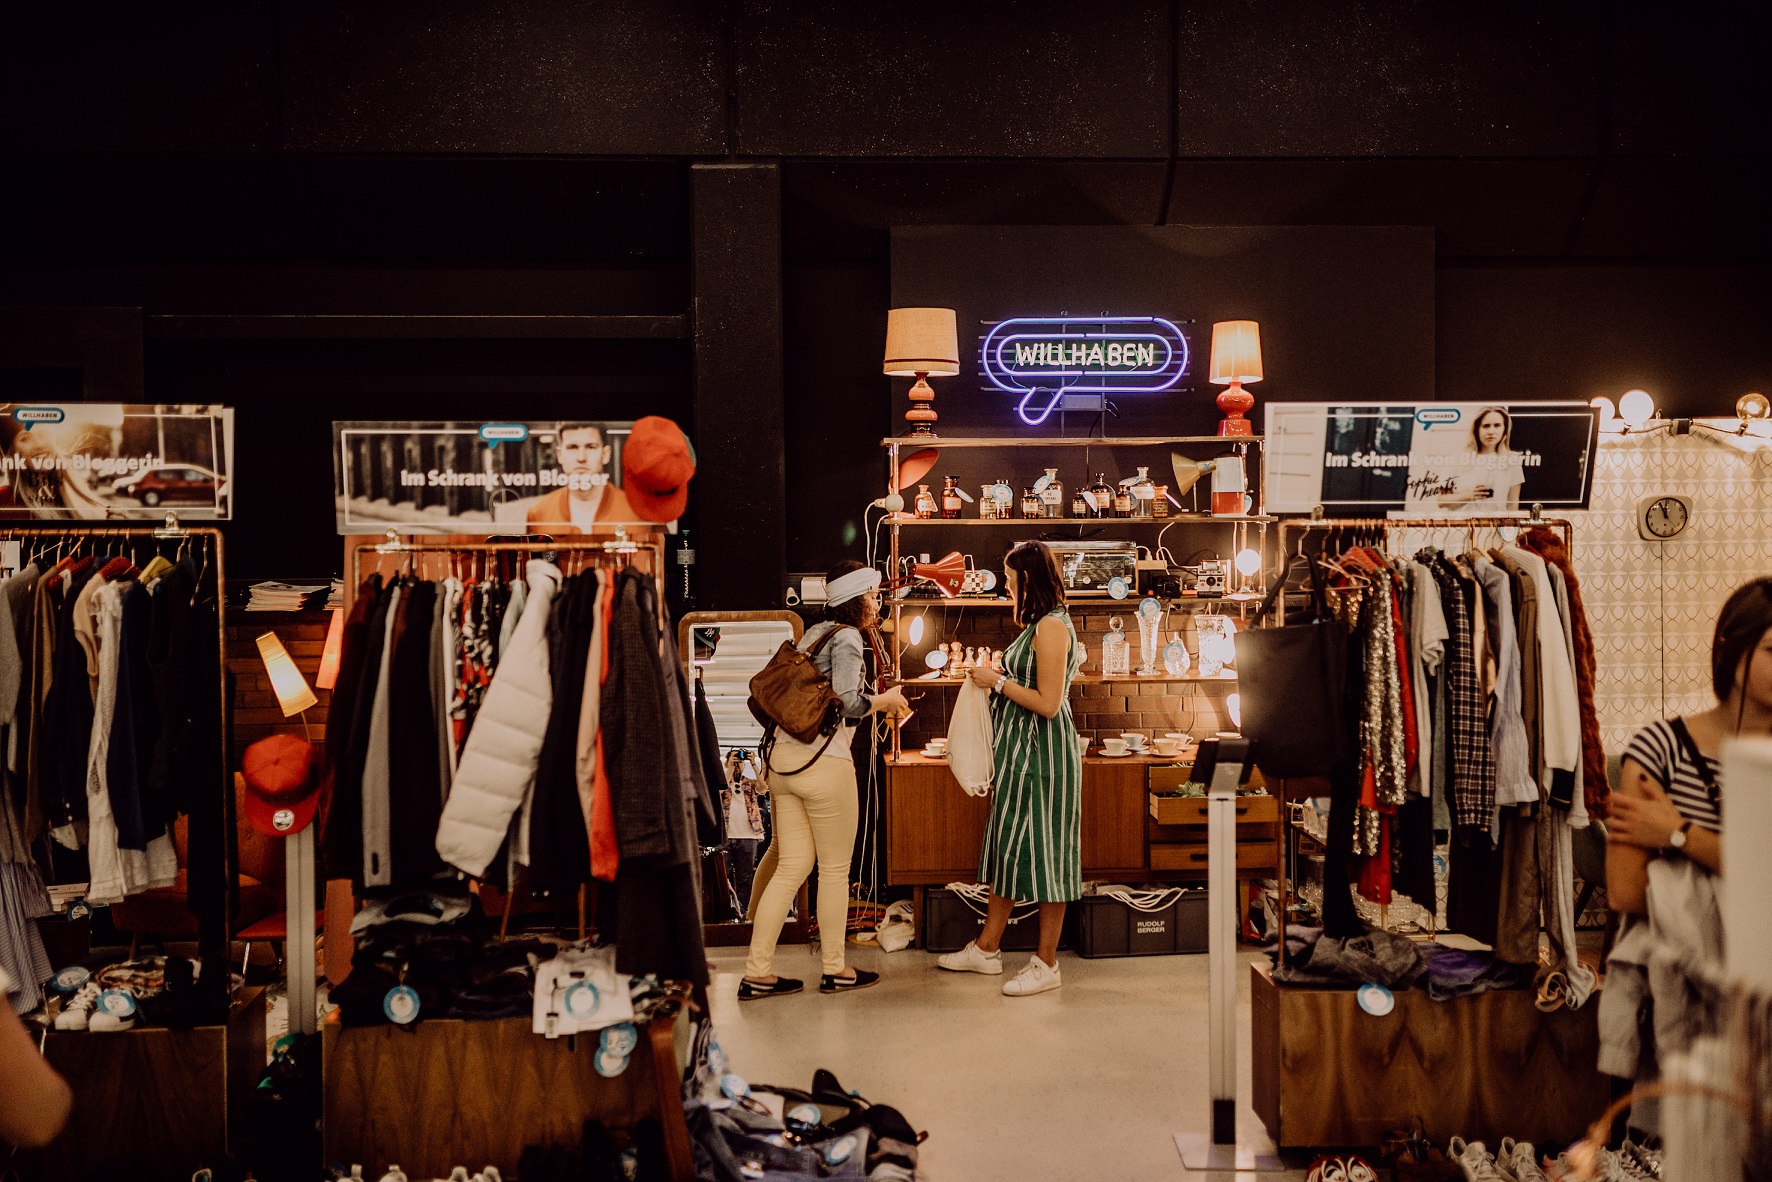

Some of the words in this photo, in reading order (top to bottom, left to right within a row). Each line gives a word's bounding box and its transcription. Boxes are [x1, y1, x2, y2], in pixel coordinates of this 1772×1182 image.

[1015, 342, 1155, 367] WILLHABEN
[0, 453, 27, 470] nk
[31, 457, 67, 470] von
[72, 453, 164, 475] Bloggerin
[1325, 453, 1348, 467] Im
[1351, 451, 1418, 467] Schrank
[1424, 455, 1456, 467] von
[1460, 450, 1542, 470] Bloggerin
[401, 470, 426, 486] Im
[428, 469, 500, 486] Schrank
[502, 473, 537, 486] von
[539, 469, 609, 490] Blogger
